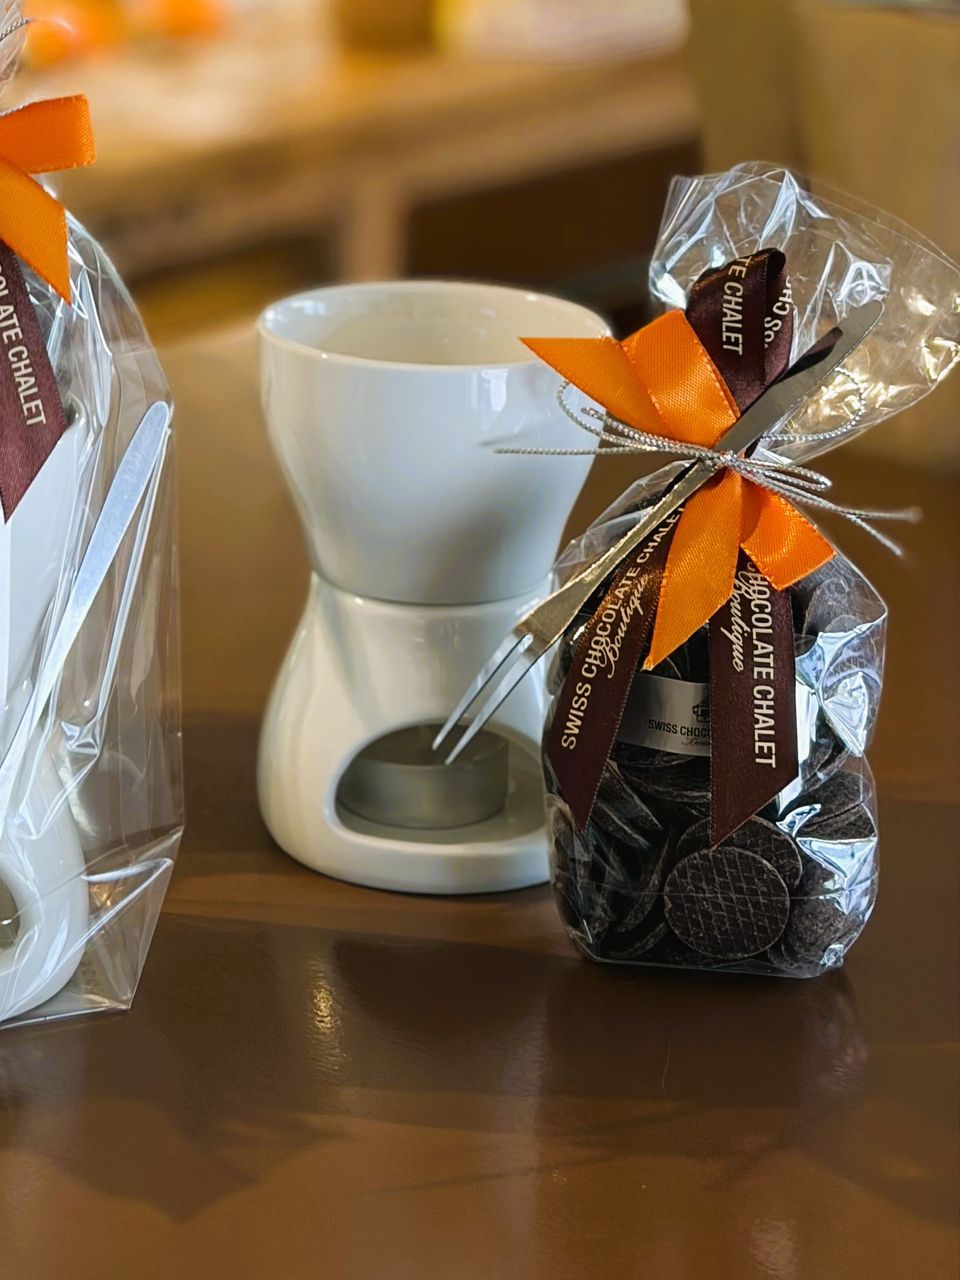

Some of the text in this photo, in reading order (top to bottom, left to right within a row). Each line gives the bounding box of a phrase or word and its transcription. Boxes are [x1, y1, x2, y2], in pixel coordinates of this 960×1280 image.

[722, 281, 743, 356] CHALET
[7, 345, 46, 426] CHALET
[562, 682, 592, 750] SWISS
[582, 564, 640, 678] CHOCOLATE
[598, 574, 650, 679] Boutique
[647, 718, 678, 735] SWISS
[753, 686, 776, 769] CHALET
